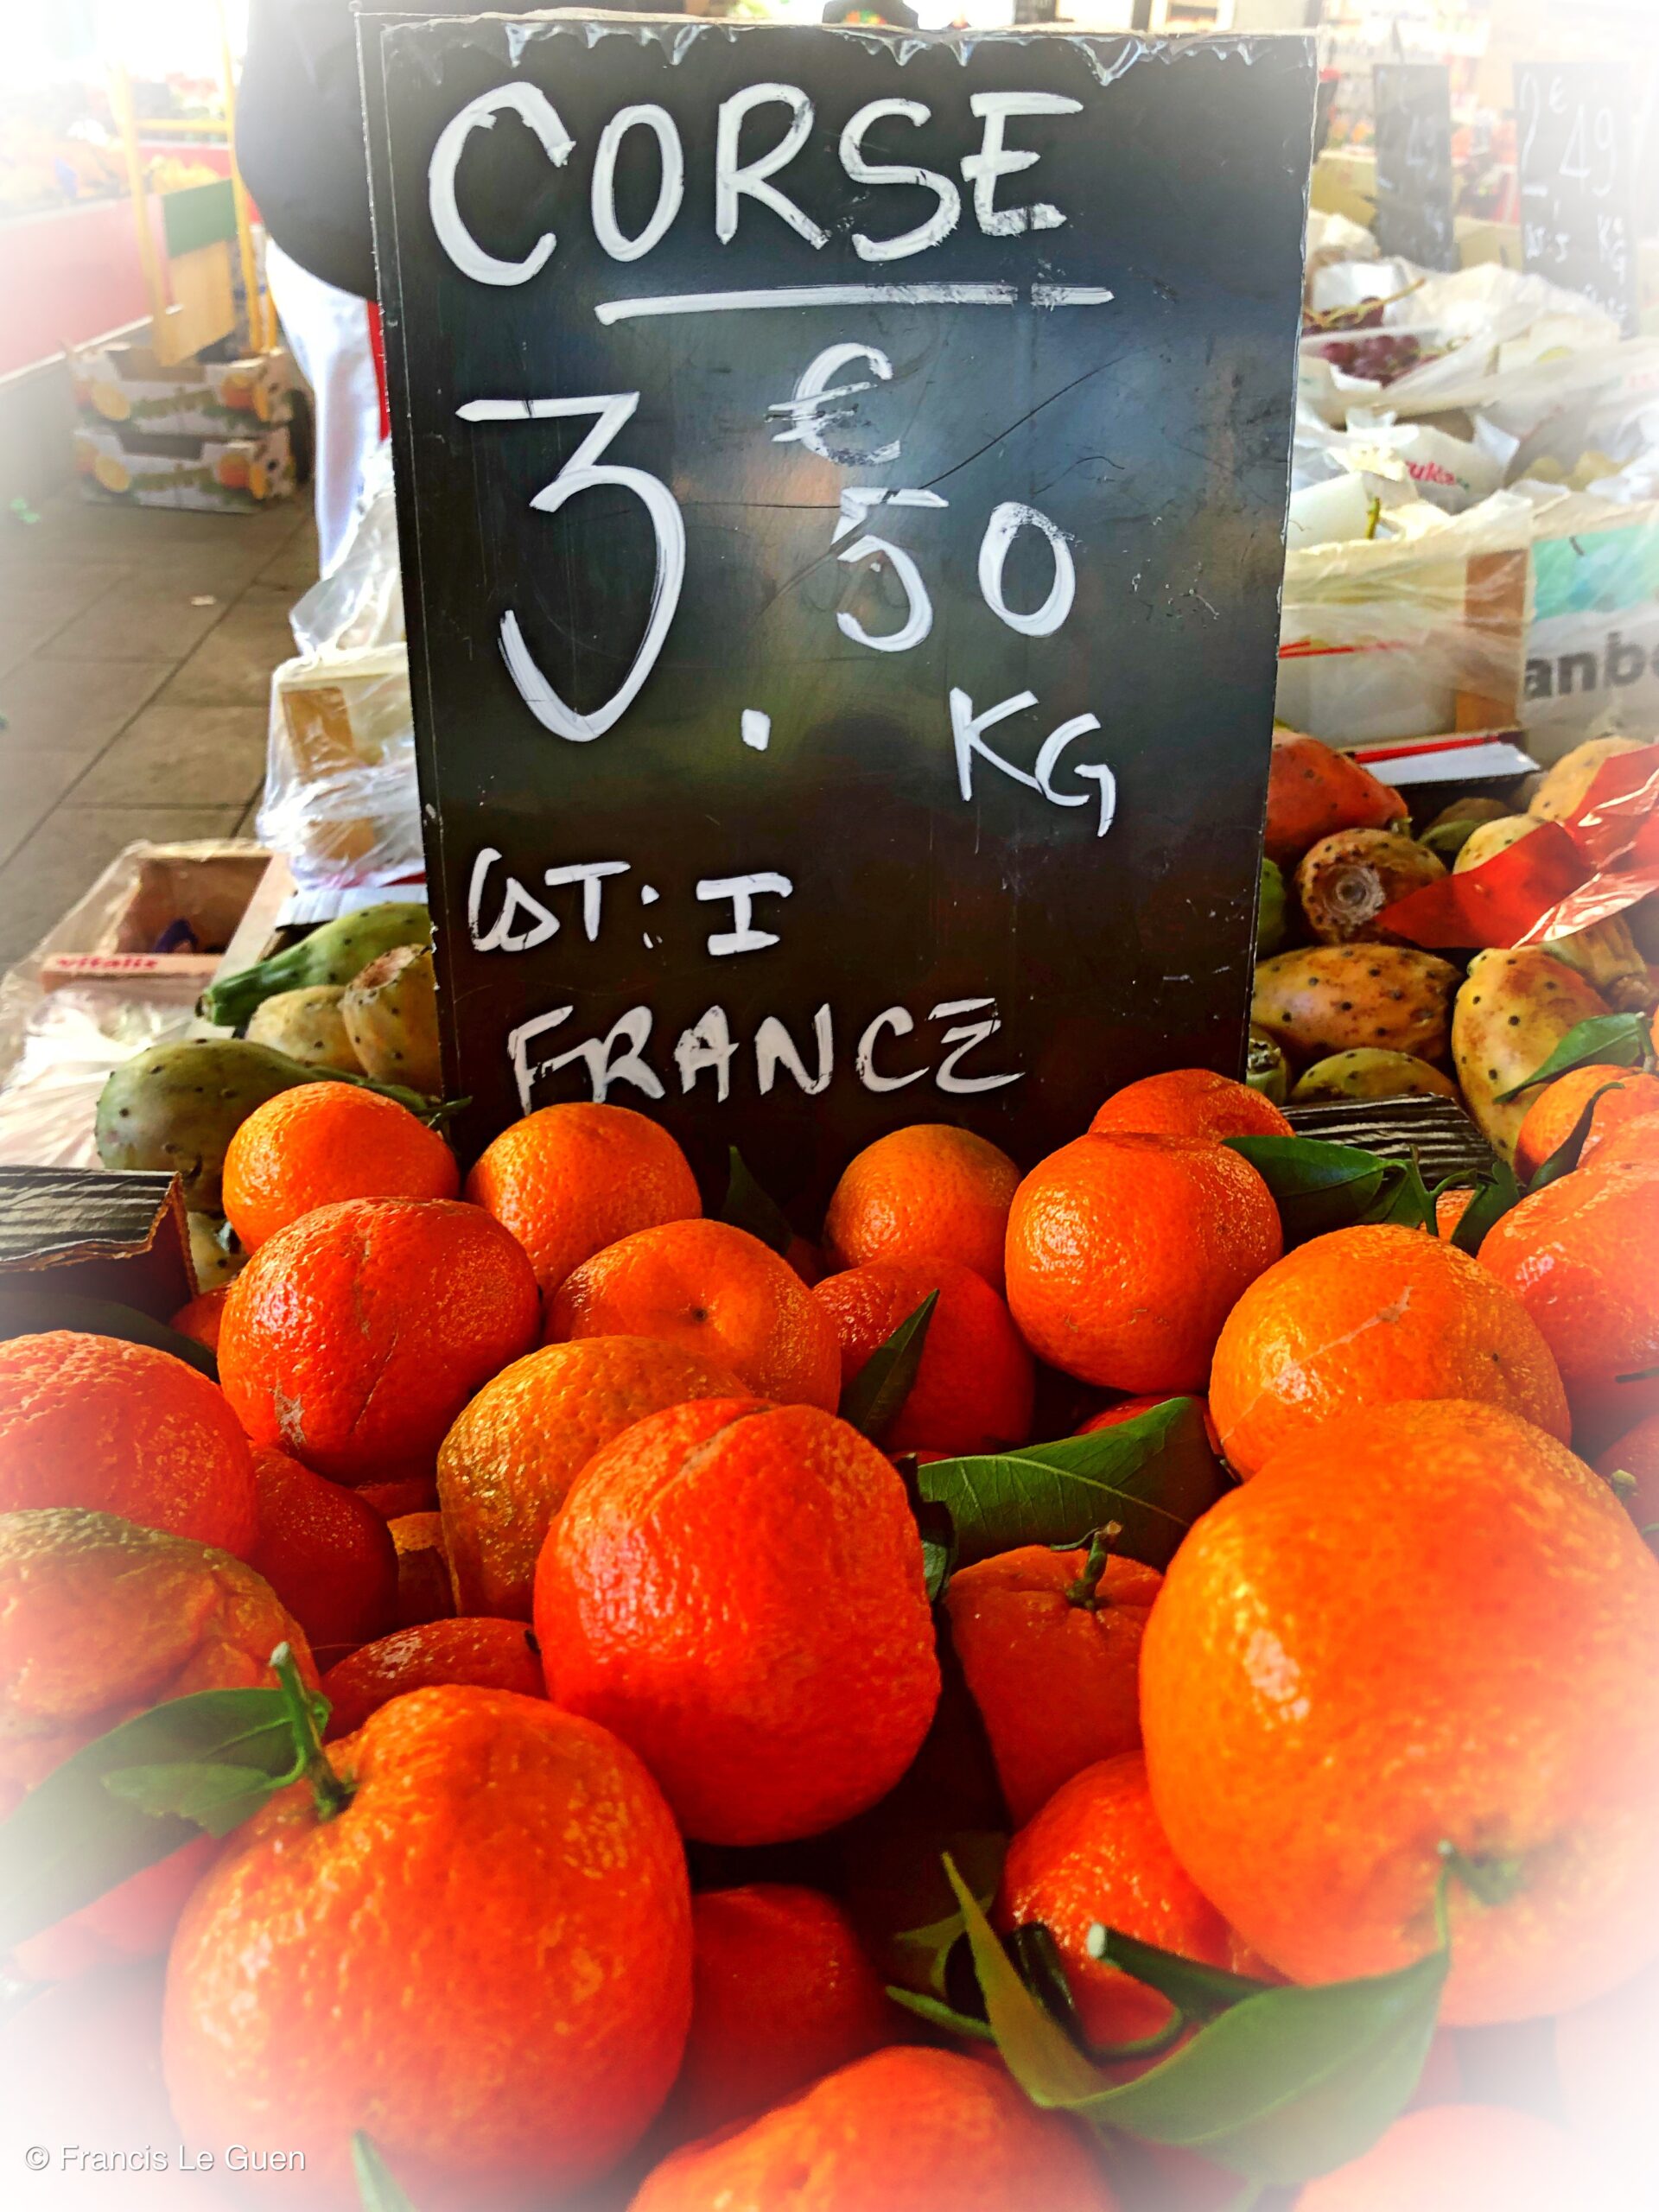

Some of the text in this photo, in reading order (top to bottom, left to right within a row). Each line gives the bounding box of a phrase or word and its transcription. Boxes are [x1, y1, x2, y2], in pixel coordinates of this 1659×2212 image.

[429, 81, 1084, 287] CORSE
[831, 486, 1076, 652] 50
[1524, 632, 1659, 701] anb
[950, 687, 1117, 838] KG
[696, 872, 794, 956] I
[507, 997, 1025, 1116] FRANCE
